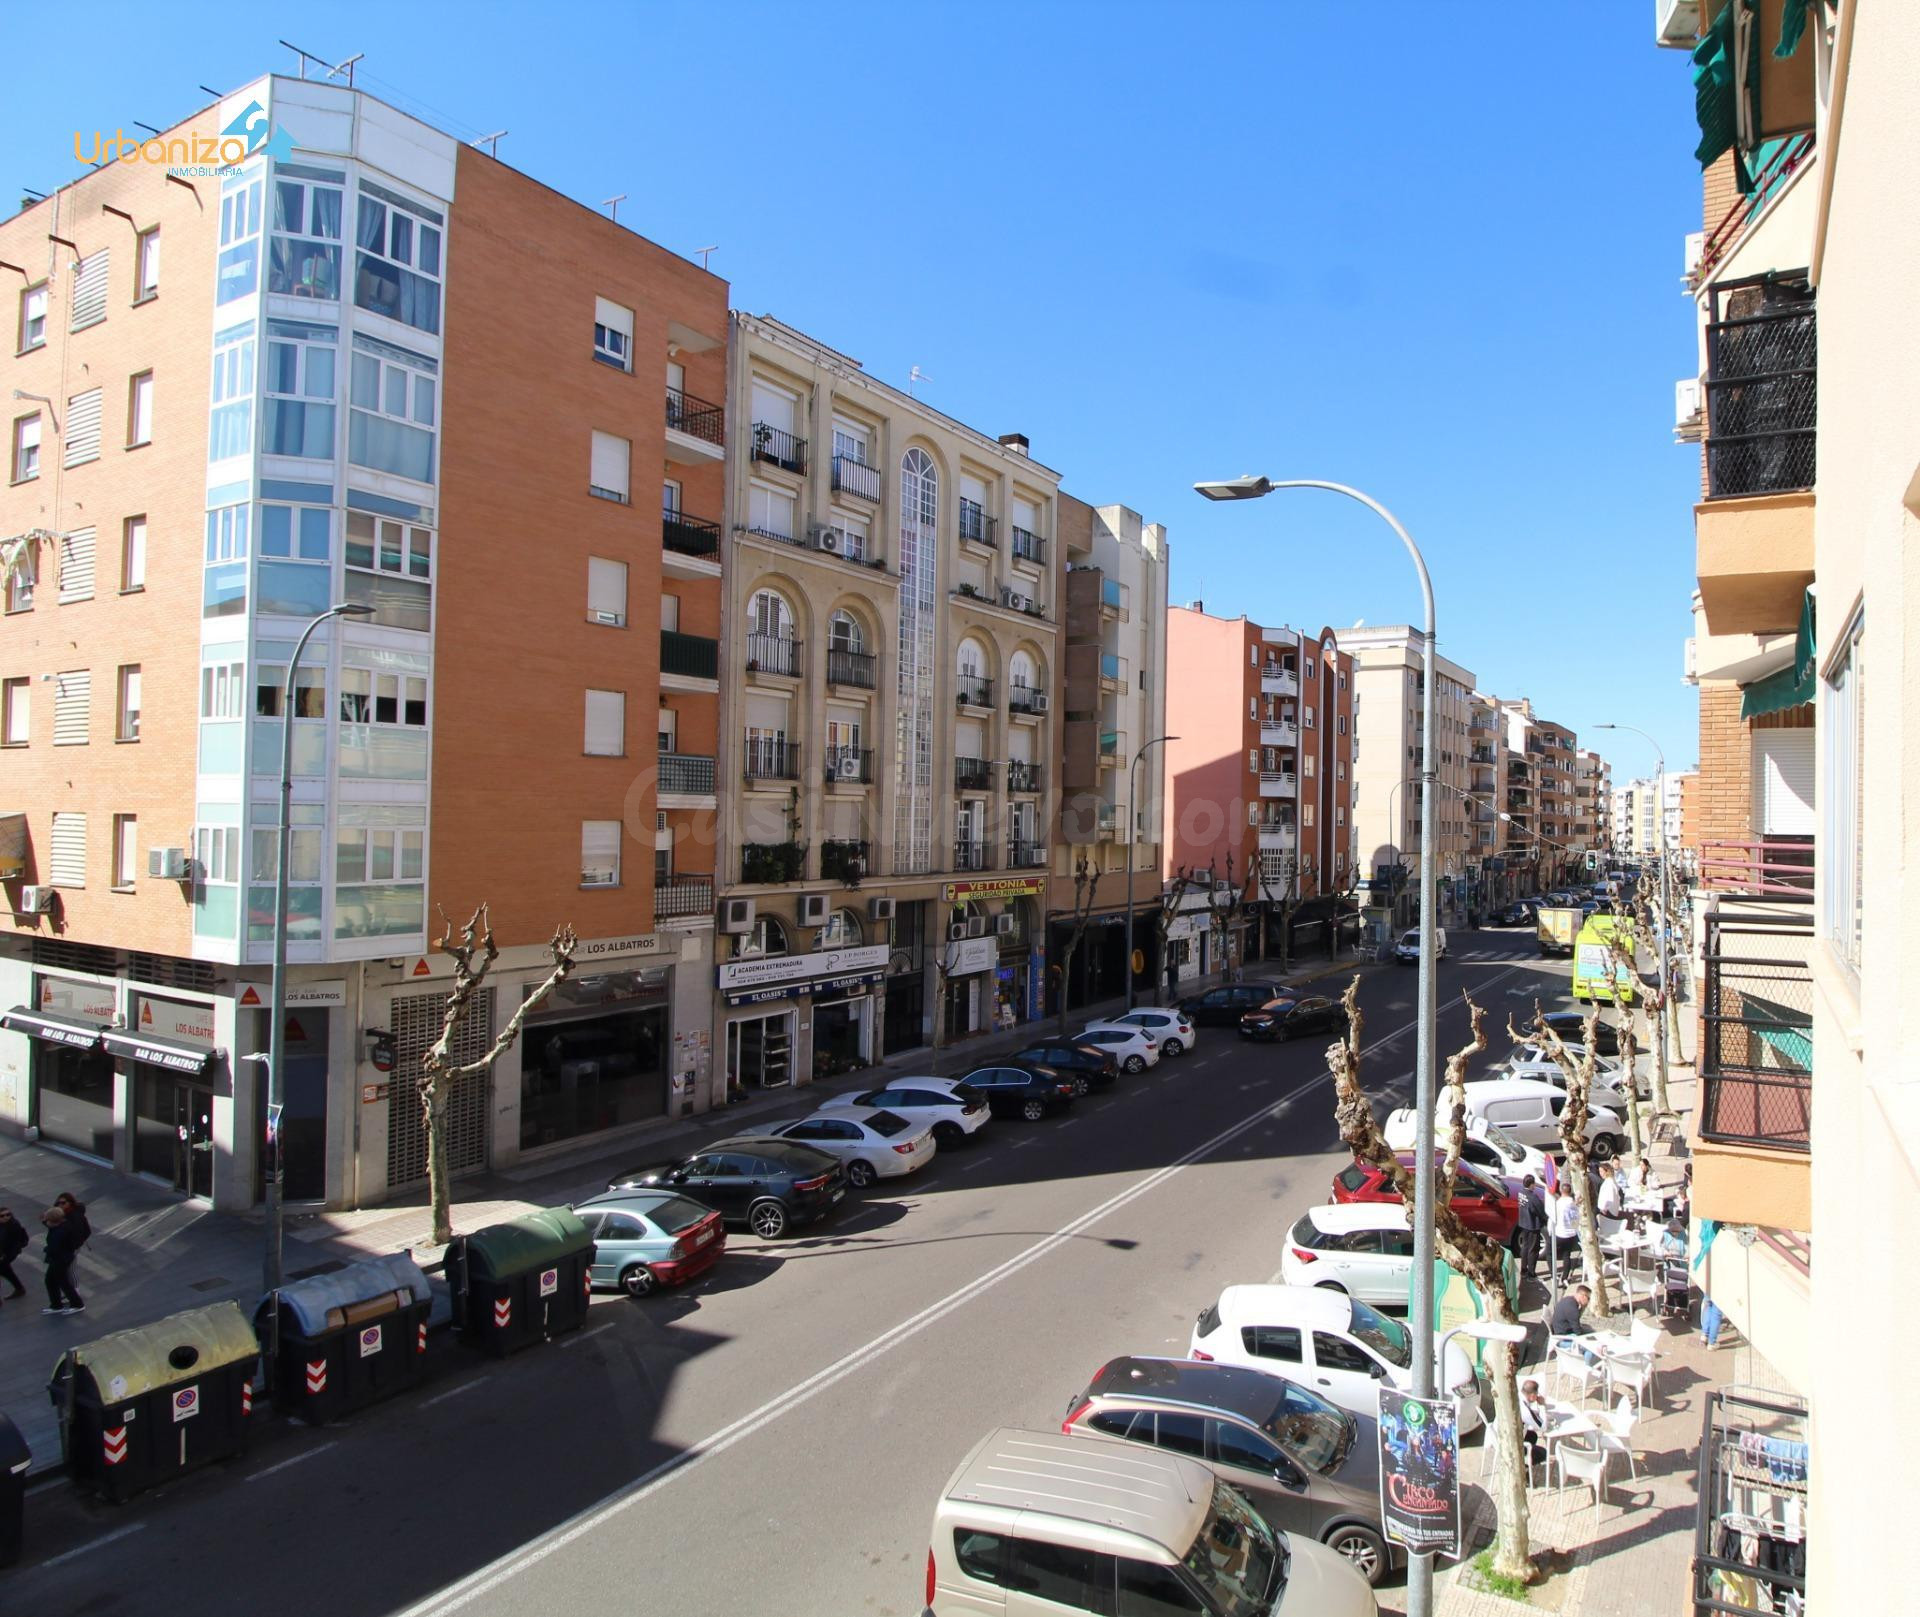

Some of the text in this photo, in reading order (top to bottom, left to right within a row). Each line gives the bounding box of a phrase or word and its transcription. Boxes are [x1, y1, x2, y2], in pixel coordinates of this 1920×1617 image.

[969, 880, 1026, 890] VETTONIA
[969, 887, 1025, 899] SEGURIDAD PRIVADA
[587, 944, 605, 954] LOS
[607, 939, 655, 952] ALBATROS
[738, 960, 803, 974] ACADEMIA EXTREMADURA
[175, 1023, 187, 1034] LOS
[52, 1030, 65, 1041] LOS
[64, 1034, 95, 1047] ALBATROS
[135, 1048, 200, 1070] BAR LOS ALBATROS
[1403, 1494, 1448, 1509] ENCANTADO
